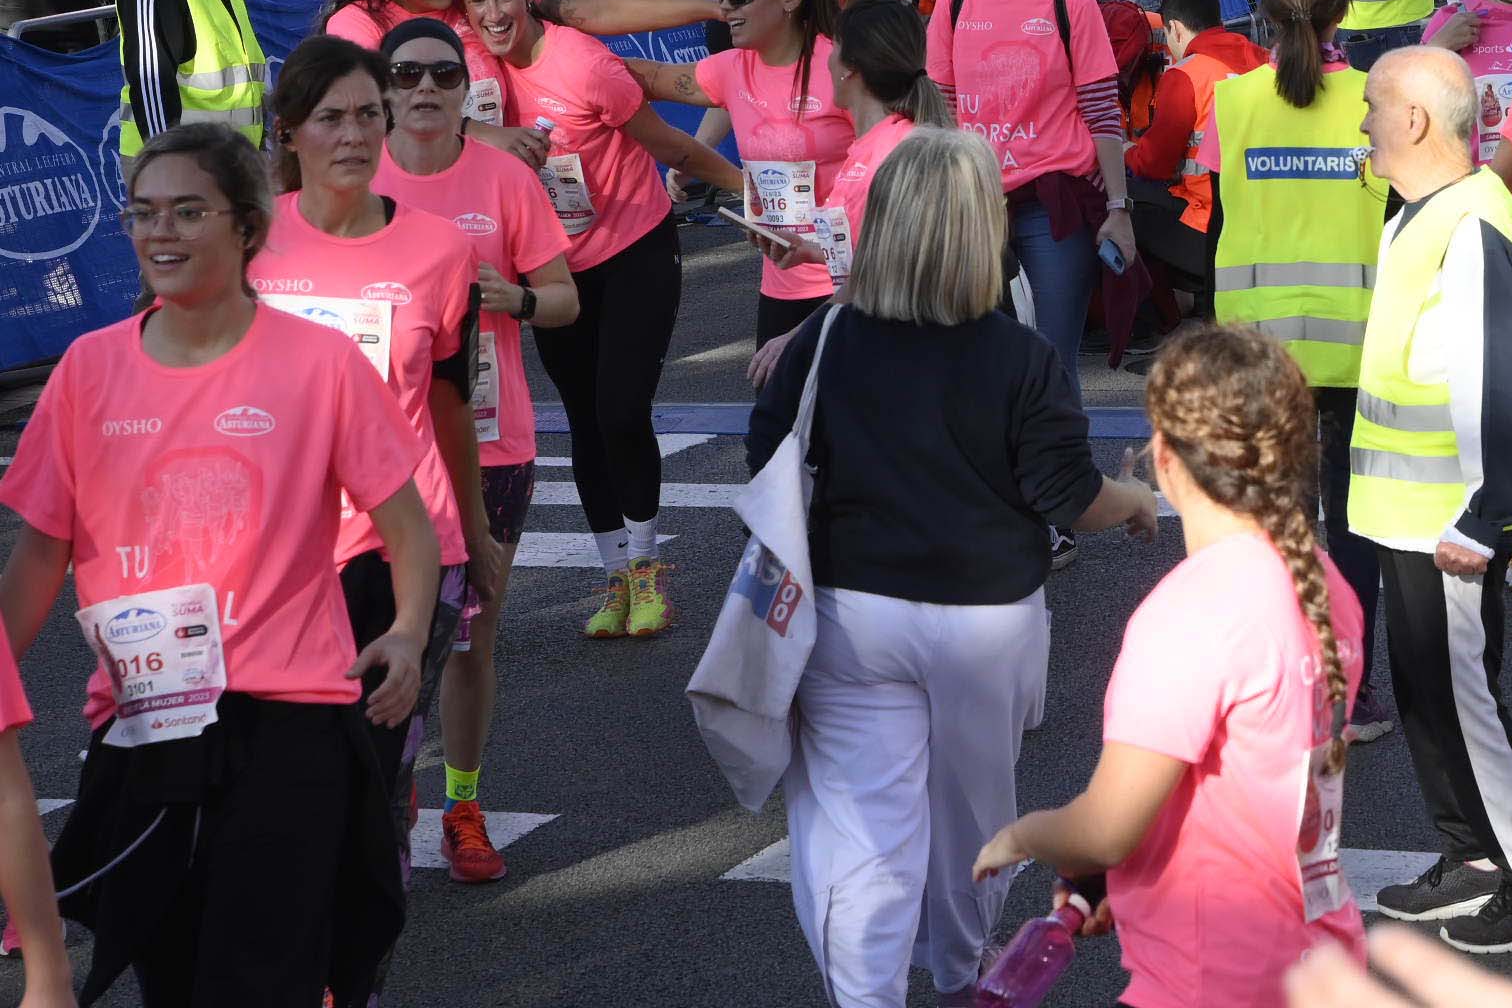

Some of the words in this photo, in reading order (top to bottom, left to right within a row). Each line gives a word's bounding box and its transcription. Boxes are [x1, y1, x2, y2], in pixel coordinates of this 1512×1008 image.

[957, 21, 993, 32] OYSHO
[1473, 42, 1504, 55] Sports
[958, 95, 981, 115] TU
[36, 152, 77, 170] LECHERA
[1248, 155, 1356, 173] VOLUNTARIS
[762, 198, 787, 211] 016
[252, 278, 313, 293] OYSHO
[366, 288, 409, 302] ASTURIANA
[102, 418, 162, 437] OYSHO
[219, 416, 272, 430] ASTURIANA
[116, 545, 150, 578] TU
[174, 603, 204, 617] SUMA
[109, 621, 162, 640] ASTURIANA
[115, 651, 164, 680] 016
[151, 695, 184, 709] MUJER
